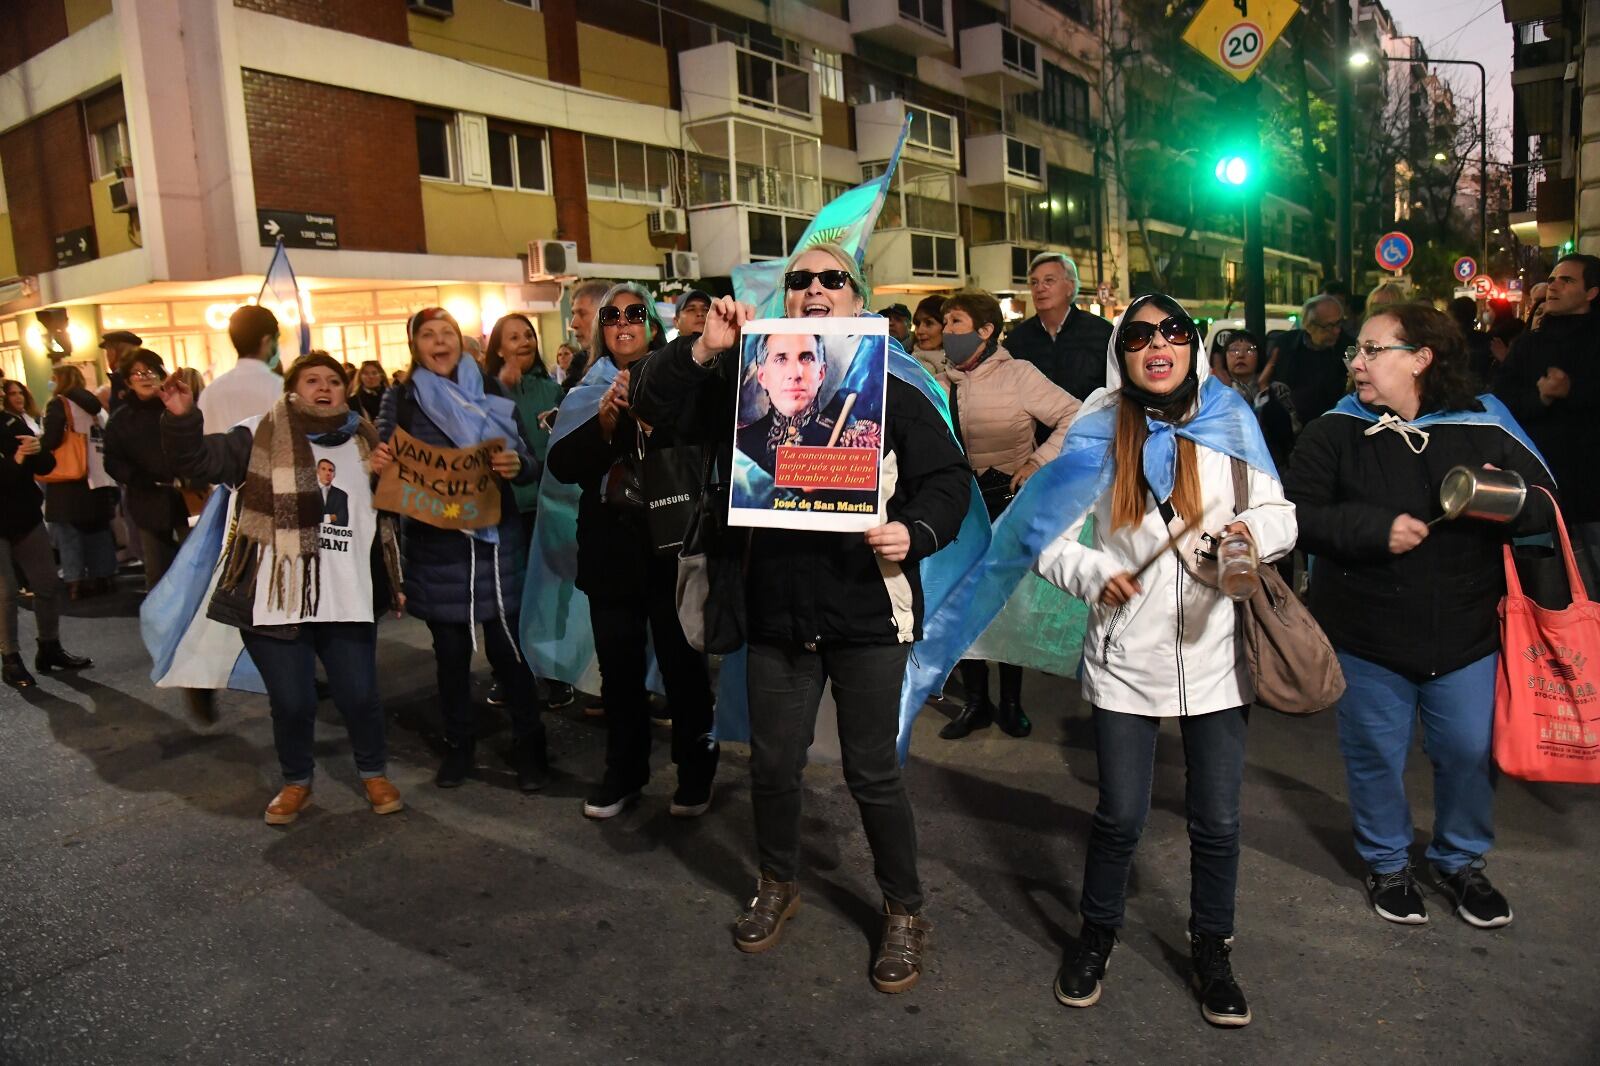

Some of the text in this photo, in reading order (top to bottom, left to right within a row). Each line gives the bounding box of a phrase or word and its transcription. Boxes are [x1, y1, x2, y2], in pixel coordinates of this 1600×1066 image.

[1228, 32, 1258, 57] 20
[394, 434, 432, 466] VAN
[435, 455, 447, 470] A
[798, 451, 846, 460] conciencia
[779, 462, 806, 472] mejor
[830, 465, 847, 473] que
[850, 464, 874, 473] tiene
[398, 463, 488, 496] EN CULO
[793, 472, 828, 482] hombre
[831, 474, 842, 482] de
[649, 493, 690, 509] SAMSUNG
[773, 497, 797, 510] José
[798, 499, 812, 510] de
[813, 500, 835, 511] San
